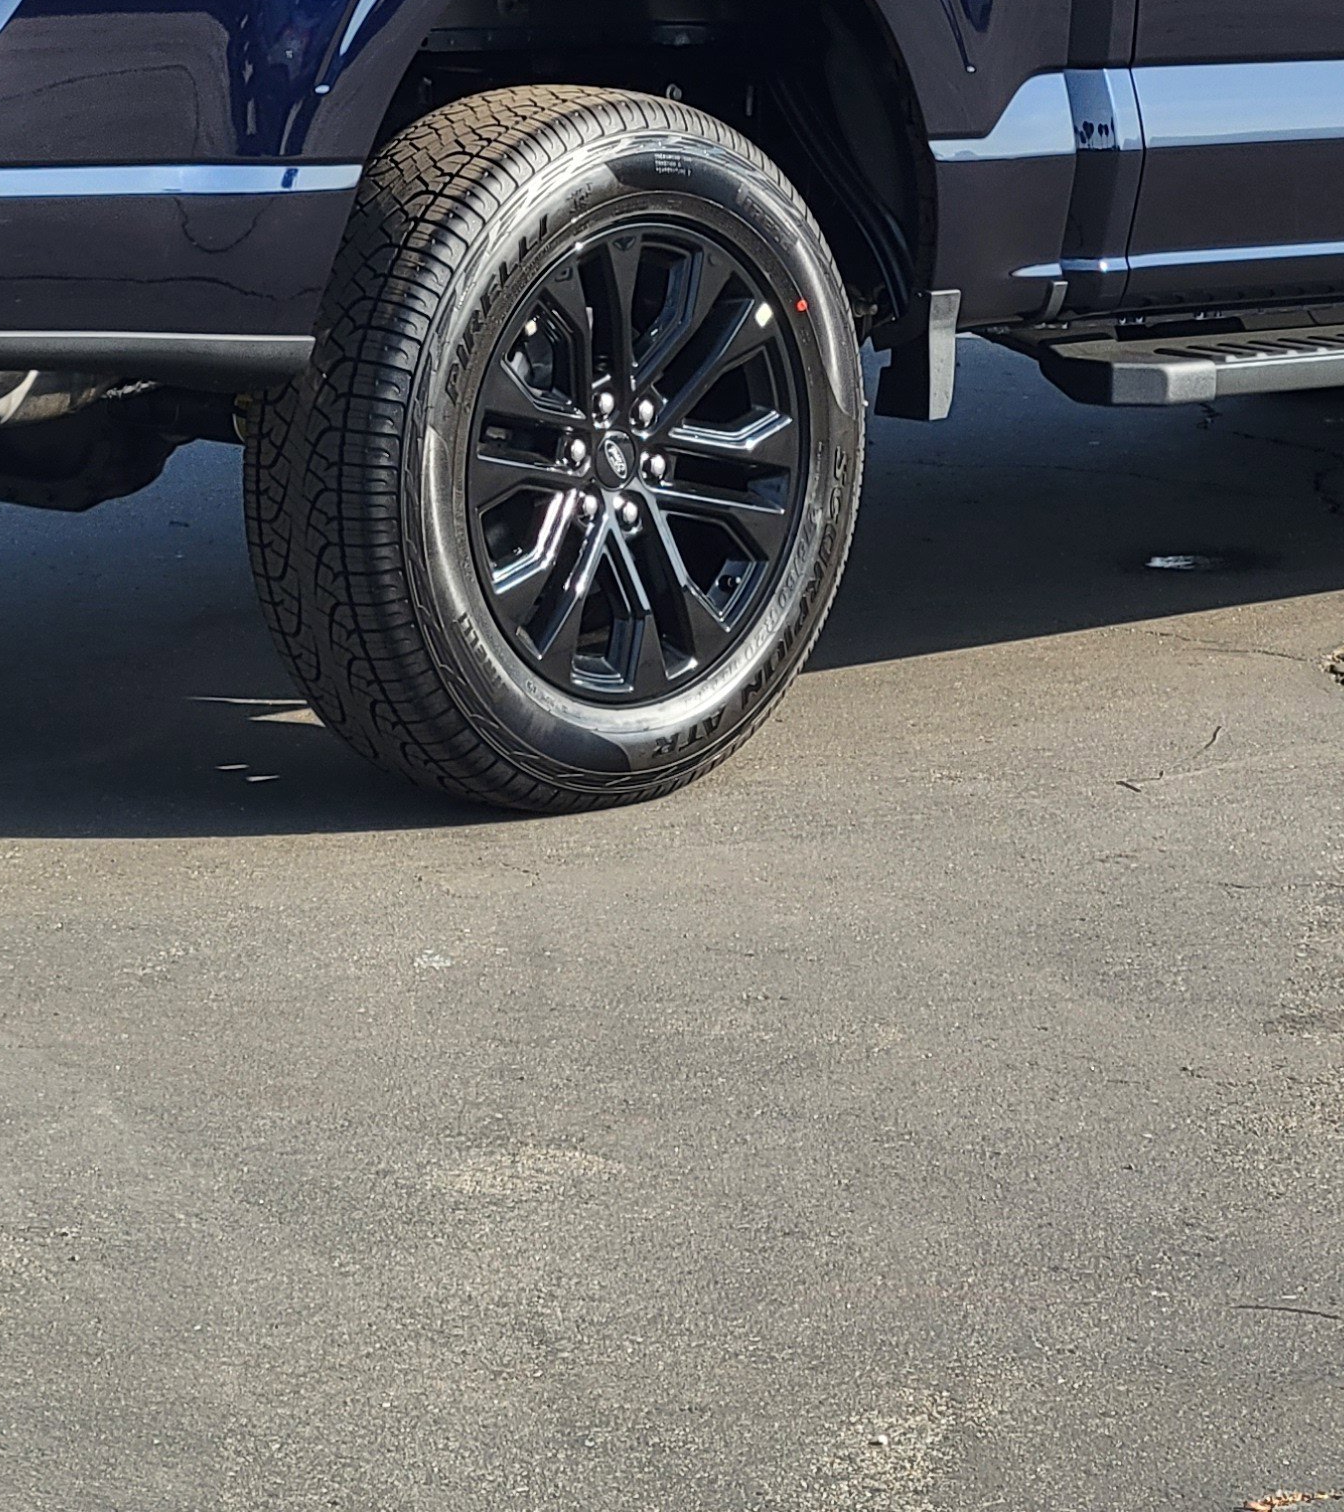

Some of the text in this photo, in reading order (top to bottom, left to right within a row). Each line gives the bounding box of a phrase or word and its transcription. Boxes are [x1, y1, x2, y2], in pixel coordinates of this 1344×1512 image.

[445, 213, 549, 406] PIRELLI
[741, 445, 849, 710] SCORPION
[652, 704, 727, 759] ATR
